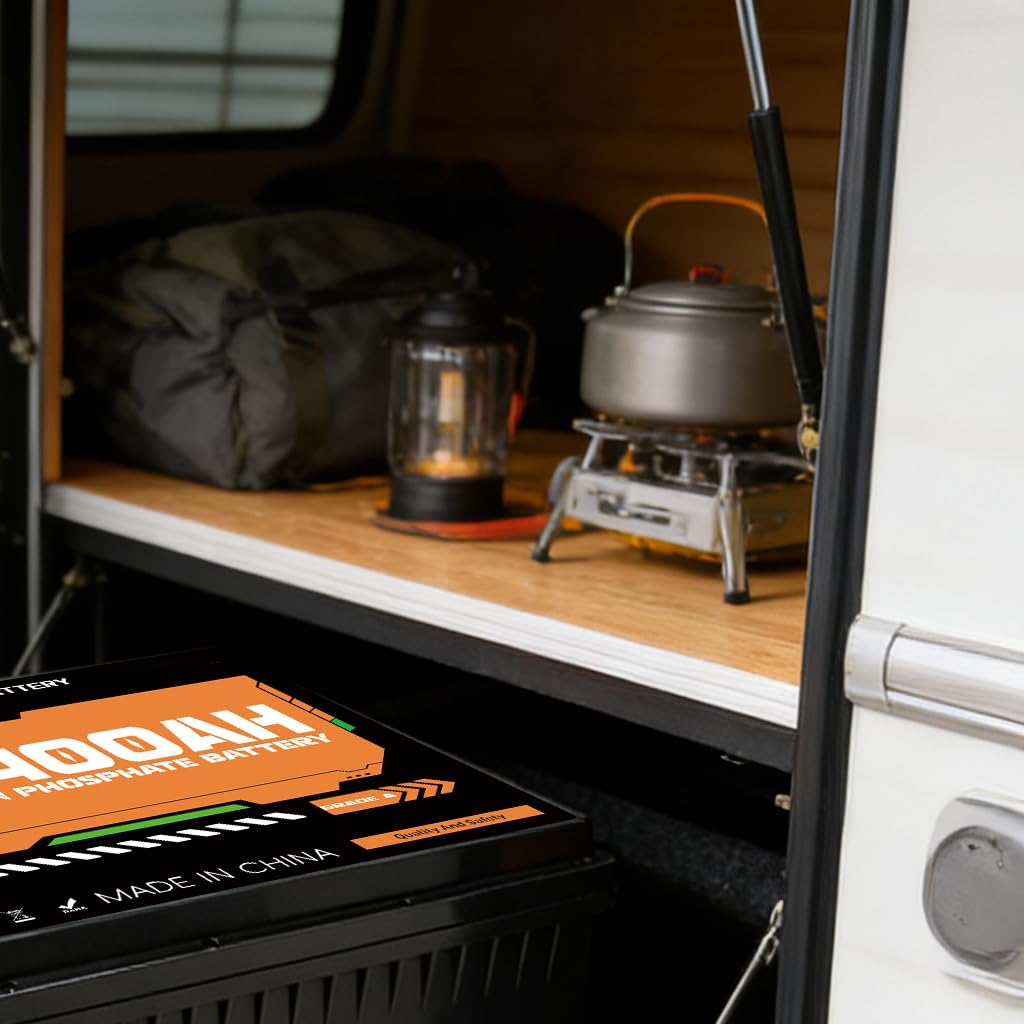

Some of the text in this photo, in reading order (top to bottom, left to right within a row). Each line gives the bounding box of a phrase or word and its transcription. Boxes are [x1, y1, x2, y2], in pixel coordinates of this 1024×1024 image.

[12, 757, 200, 797] PHOSPHATE
[199, 732, 333, 764] BATTERY
[319, 792, 397, 811] GRADE A
[393, 826, 441, 841] Quality
[440, 821, 467, 831] And
[93, 848, 341, 904] MADE IN CHINA
